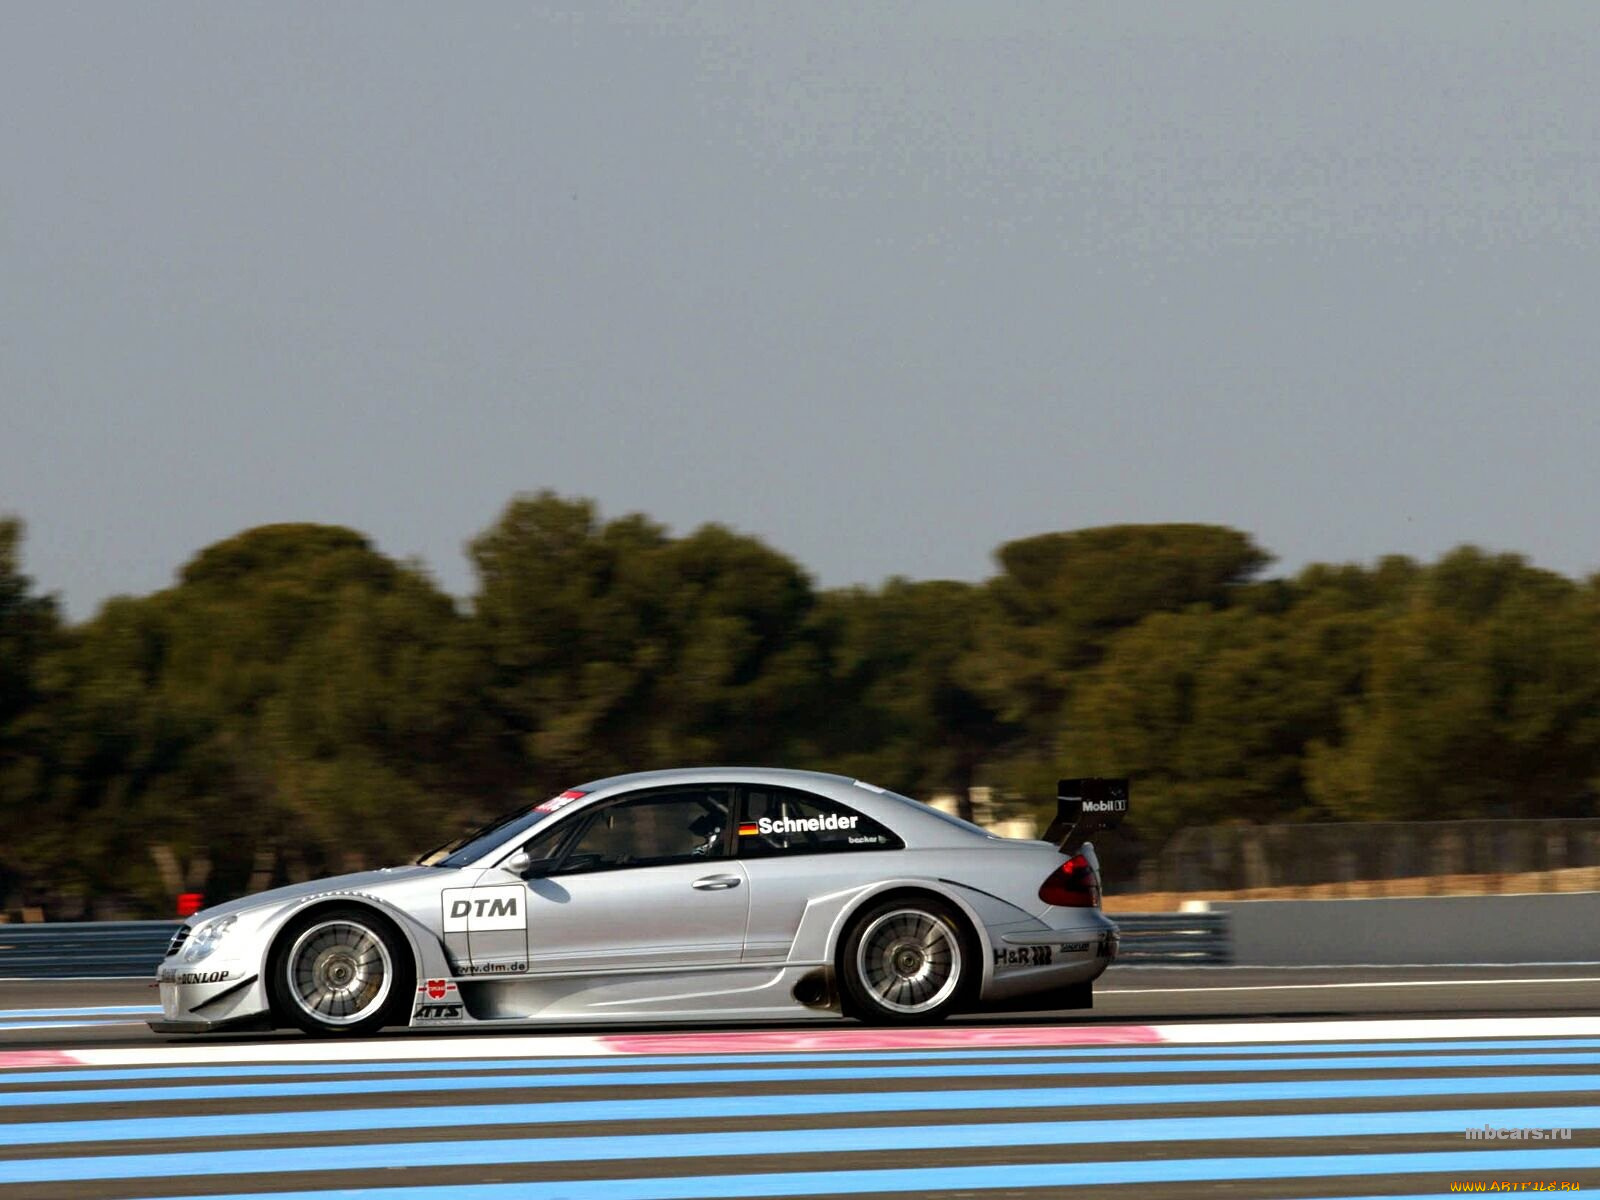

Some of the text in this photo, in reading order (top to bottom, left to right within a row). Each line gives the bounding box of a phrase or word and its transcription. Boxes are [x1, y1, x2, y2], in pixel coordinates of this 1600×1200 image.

[1082, 800, 1114, 812] Mobil
[759, 814, 858, 834] Schneider
[450, 898, 517, 918] DTM
[993, 945, 1029, 965] H&R
[455, 962, 525, 974] ww.dtm.de
[181, 970, 229, 985] DUNLOP
[413, 1004, 463, 1018] ATS
